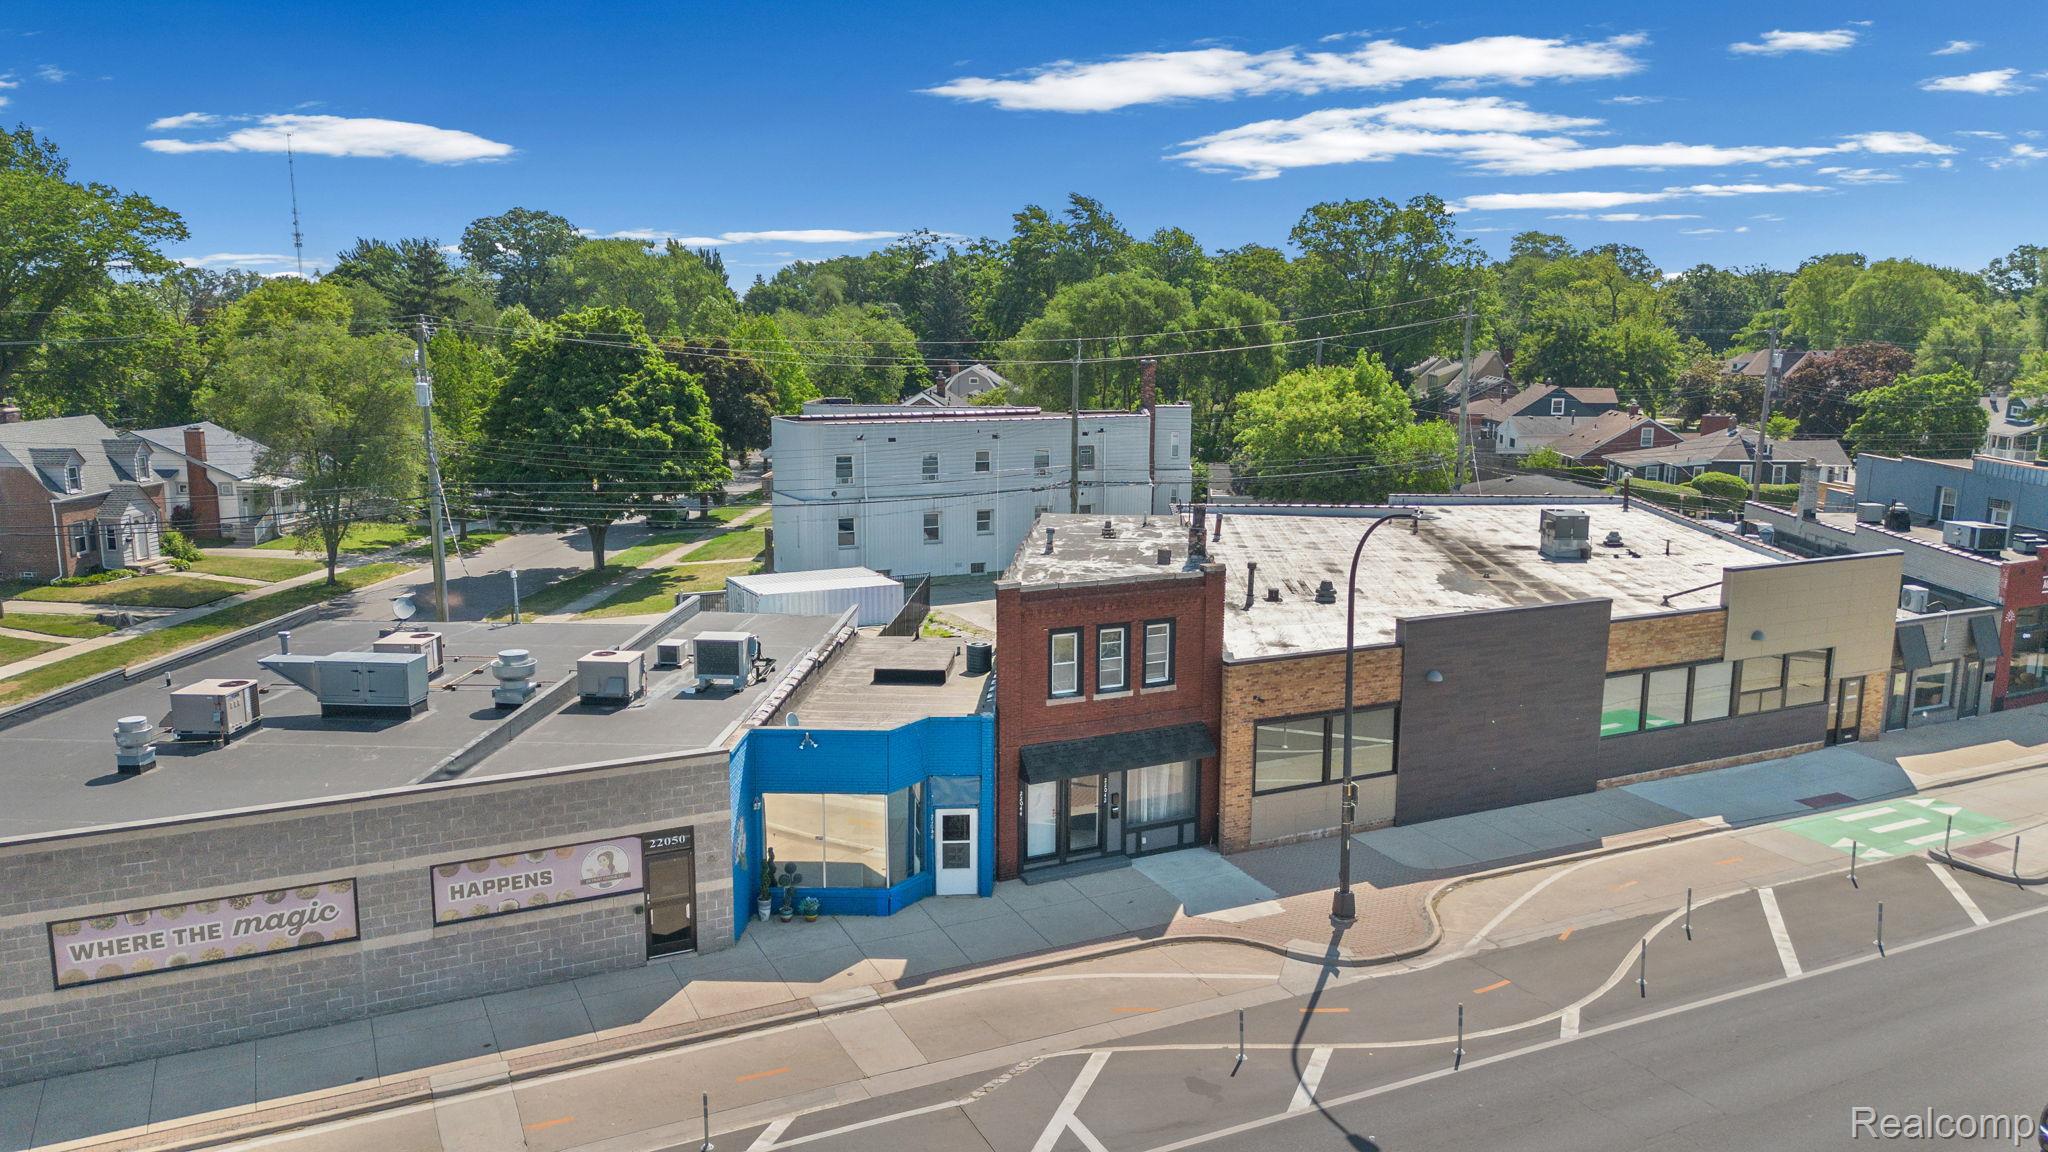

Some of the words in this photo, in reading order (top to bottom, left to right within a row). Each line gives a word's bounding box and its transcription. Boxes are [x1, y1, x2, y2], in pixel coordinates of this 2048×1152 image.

[649, 834, 686, 848] 22050
[449, 870, 553, 901] HAPPENS
[68, 931, 166, 962] WHERE
[172, 922, 222, 945] THE
[232, 900, 340, 937] magic
